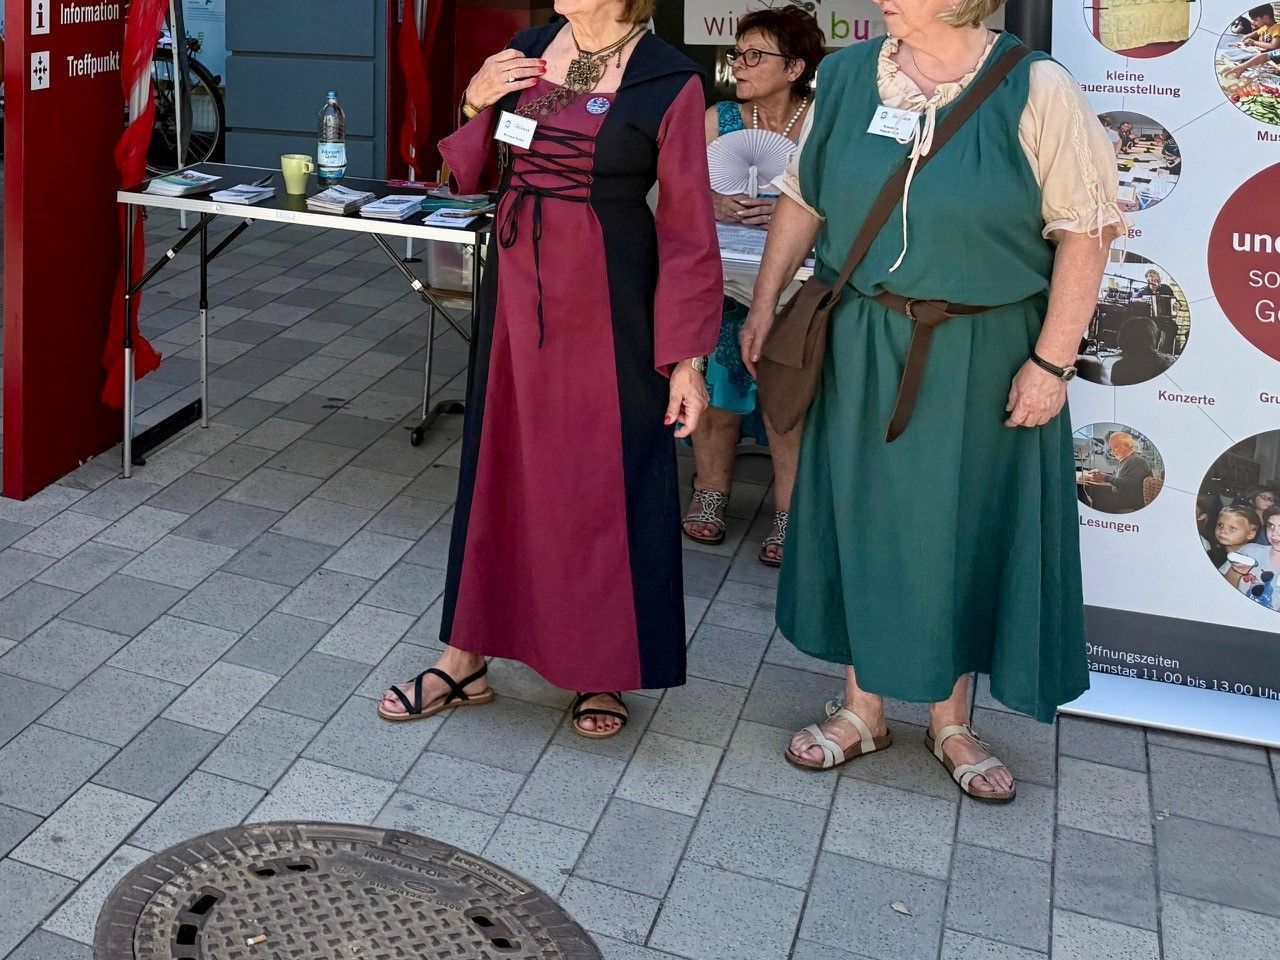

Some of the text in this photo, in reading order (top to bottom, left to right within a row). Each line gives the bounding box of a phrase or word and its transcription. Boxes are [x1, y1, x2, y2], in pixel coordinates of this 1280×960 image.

[60, 0, 119, 25] Information
[704, 11, 739, 36] wi
[67, 51, 119, 78] Treffpunkt
[1106, 70, 1145, 82] kleine
[1080, 84, 1181, 98] auerausstellung
[1158, 390, 1215, 406] Konzerte
[1079, 515, 1140, 533] Lesungen
[1142, 668, 1182, 684] 11.00
[1187, 676, 1207, 689] bis
[1212, 679, 1253, 696] 13.00
